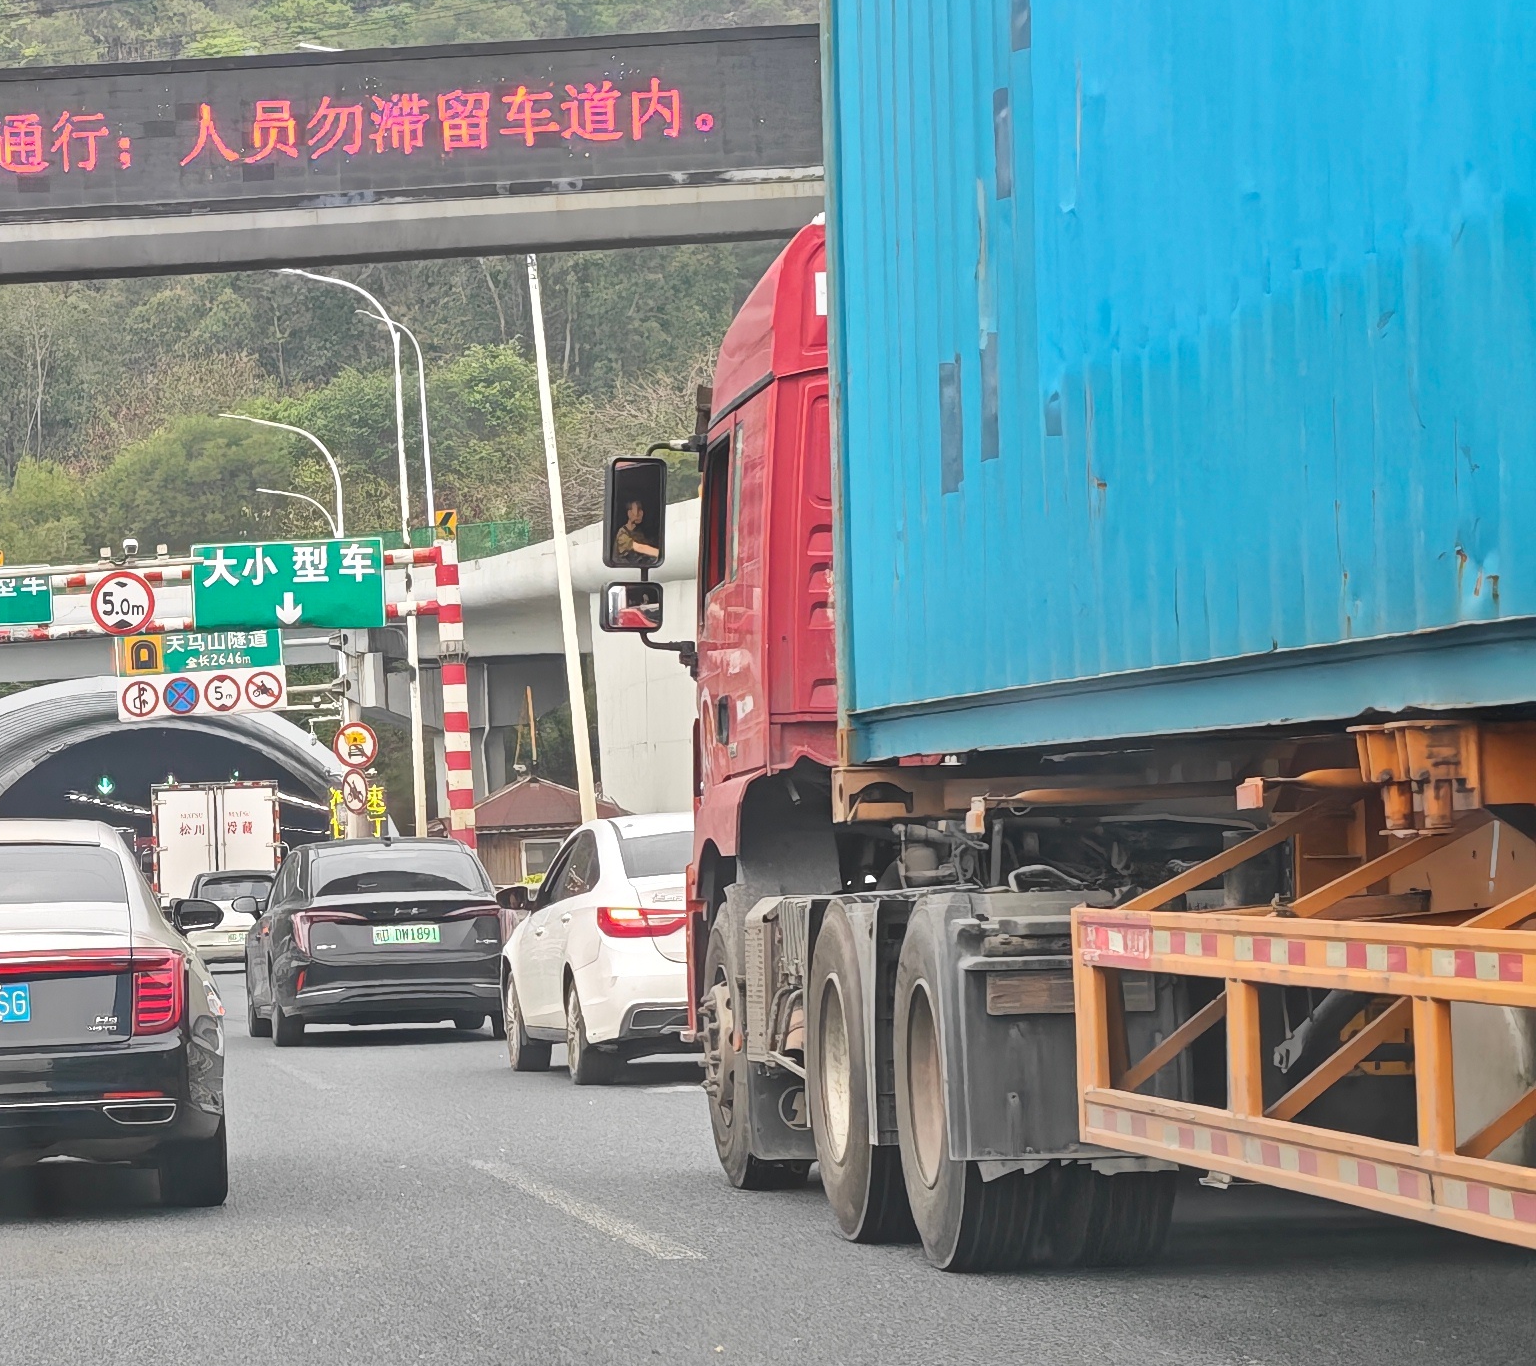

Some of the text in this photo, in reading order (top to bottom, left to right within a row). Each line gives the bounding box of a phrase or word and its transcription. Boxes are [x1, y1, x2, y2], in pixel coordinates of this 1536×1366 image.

[202, 543, 377, 587] 大小型车
[102, 591, 145, 617] 5.0m
[166, 629, 268, 653] 天马山隧道
[185, 651, 251, 669] 全长2646m
[179, 821, 205, 836] 松川
